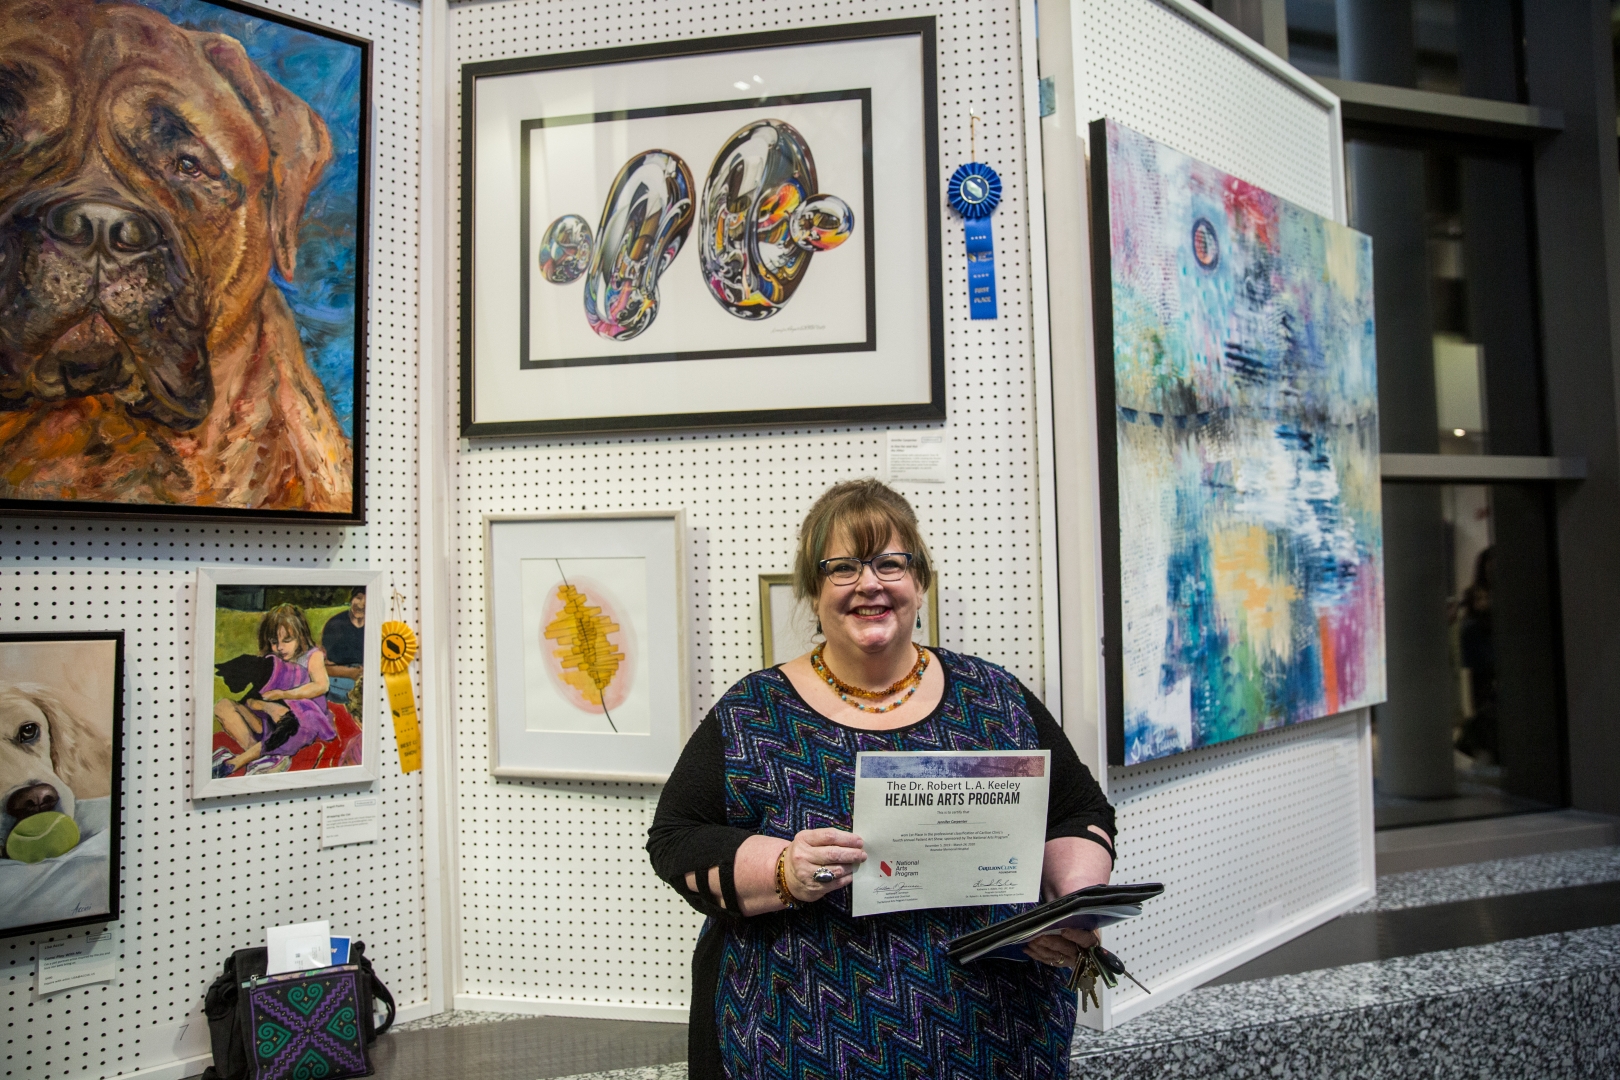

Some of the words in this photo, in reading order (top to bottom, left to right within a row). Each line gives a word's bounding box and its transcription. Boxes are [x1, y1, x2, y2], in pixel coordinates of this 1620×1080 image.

[400, 741, 411, 749] BEST
[886, 781, 907, 791] The
[909, 781, 924, 791] Dr.
[927, 781, 962, 791] Robert
[988, 780, 1021, 791] Keeley
[885, 793, 934, 807] HEALING
[937, 792, 965, 806] ARTS
[968, 791, 1021, 806] PROGRAM
